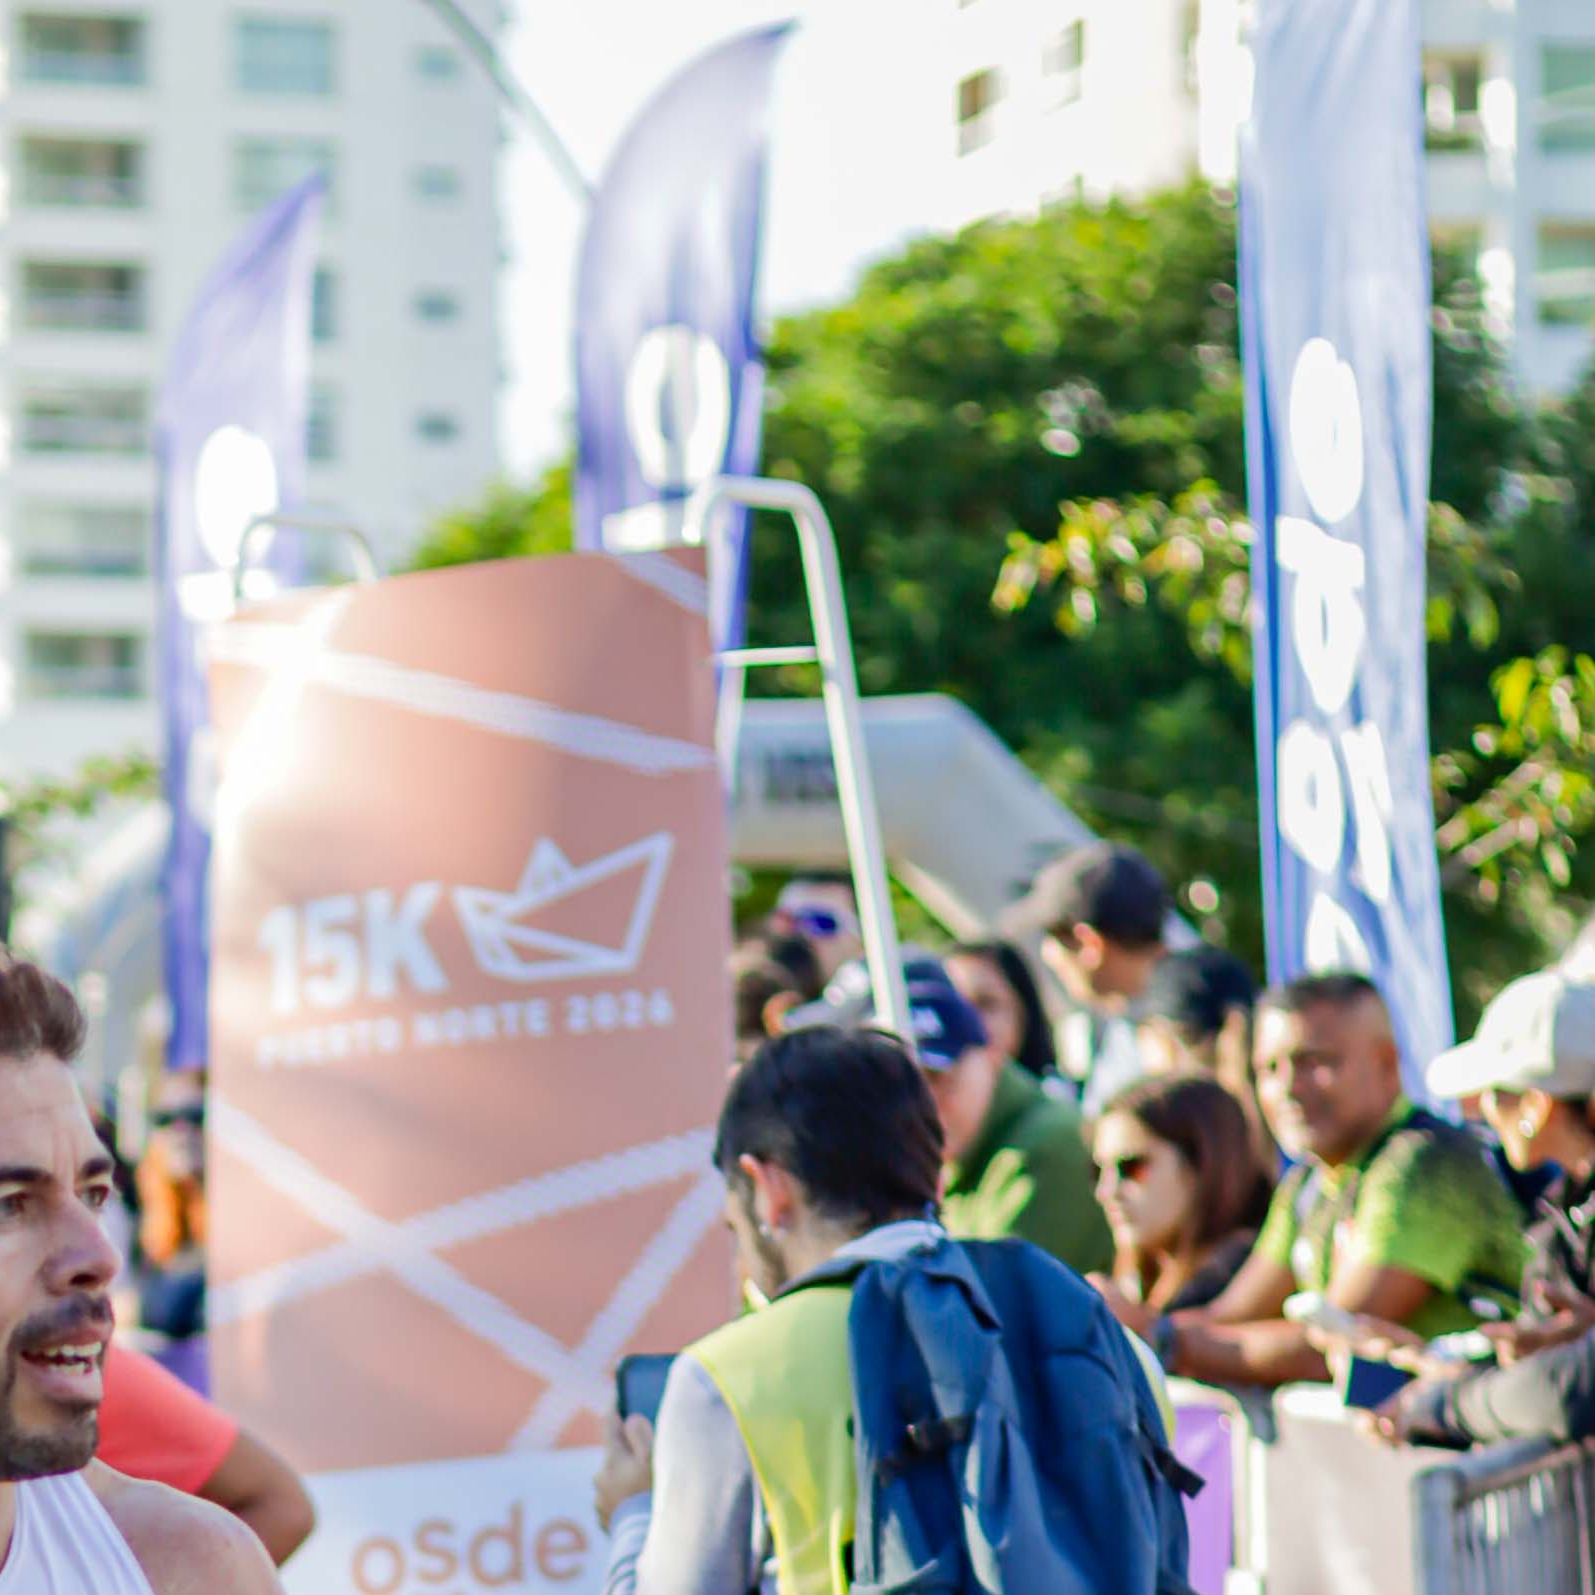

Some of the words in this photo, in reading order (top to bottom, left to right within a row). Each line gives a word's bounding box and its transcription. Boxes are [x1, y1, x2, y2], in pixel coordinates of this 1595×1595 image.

[258, 881, 449, 1014] 15K
[256, 1017, 402, 1069] PUERTO
[413, 998, 550, 1045] NORTE
[566, 987, 674, 1032] 2026
